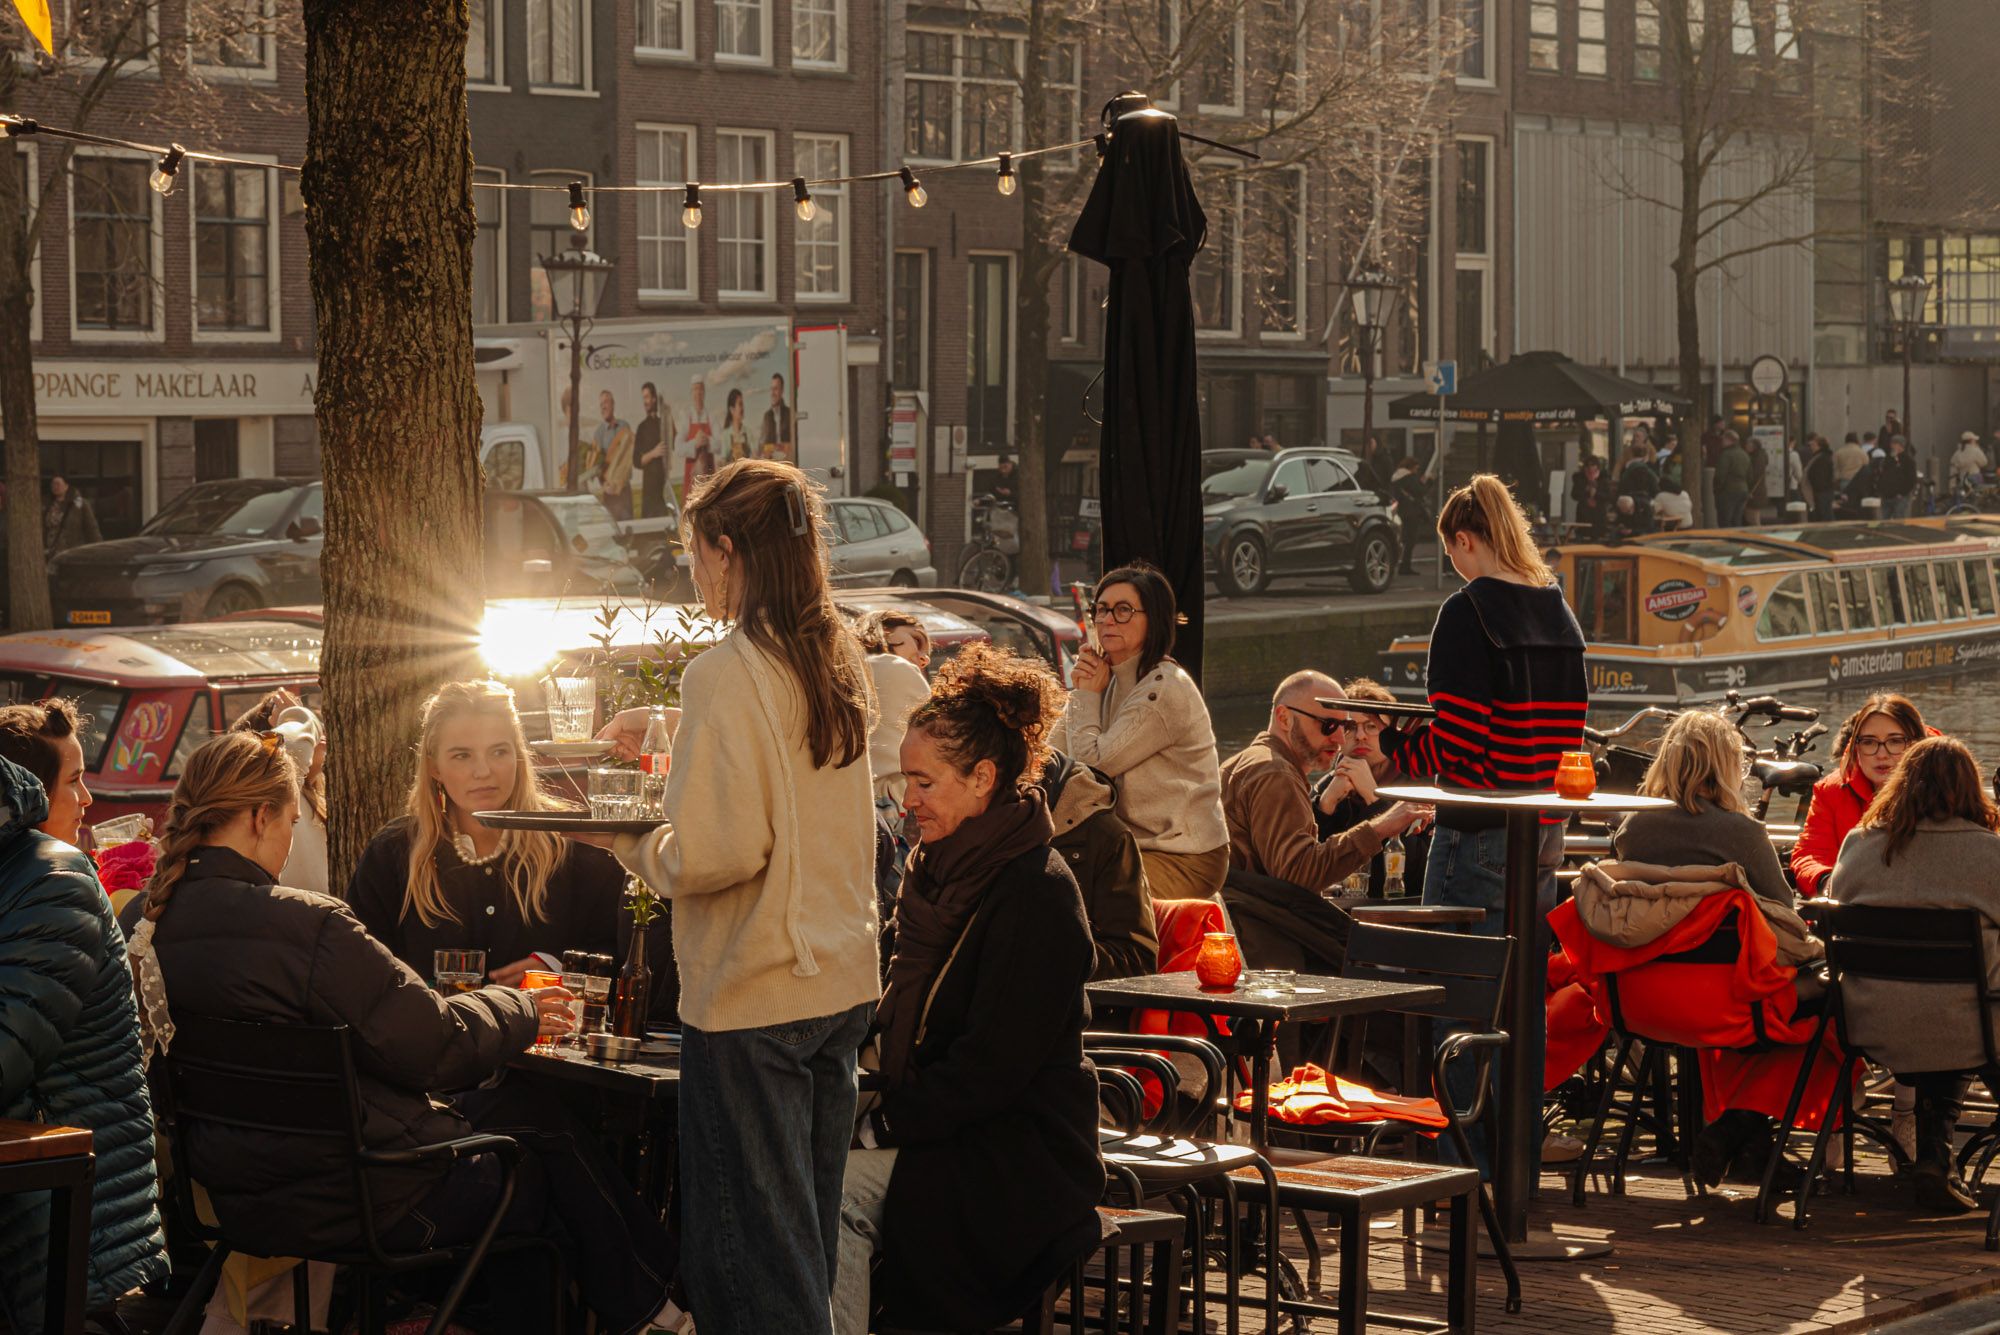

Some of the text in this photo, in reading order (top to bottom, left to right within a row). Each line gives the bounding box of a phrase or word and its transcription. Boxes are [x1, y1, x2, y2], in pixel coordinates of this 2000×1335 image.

[594, 351, 641, 370] Bidfood
[135, 373, 257, 397] MAKELAAR
[1409, 408, 1432, 418] canal
[1432, 409, 1459, 419] crise
[1535, 409, 1557, 420] canal
[1648, 590, 1704, 610] AMSTERDAM
[1841, 649, 1903, 677] amsterdam
[1904, 645, 1933, 670] circle
[1935, 641, 1954, 665] line
[1592, 665, 1633, 687] line
